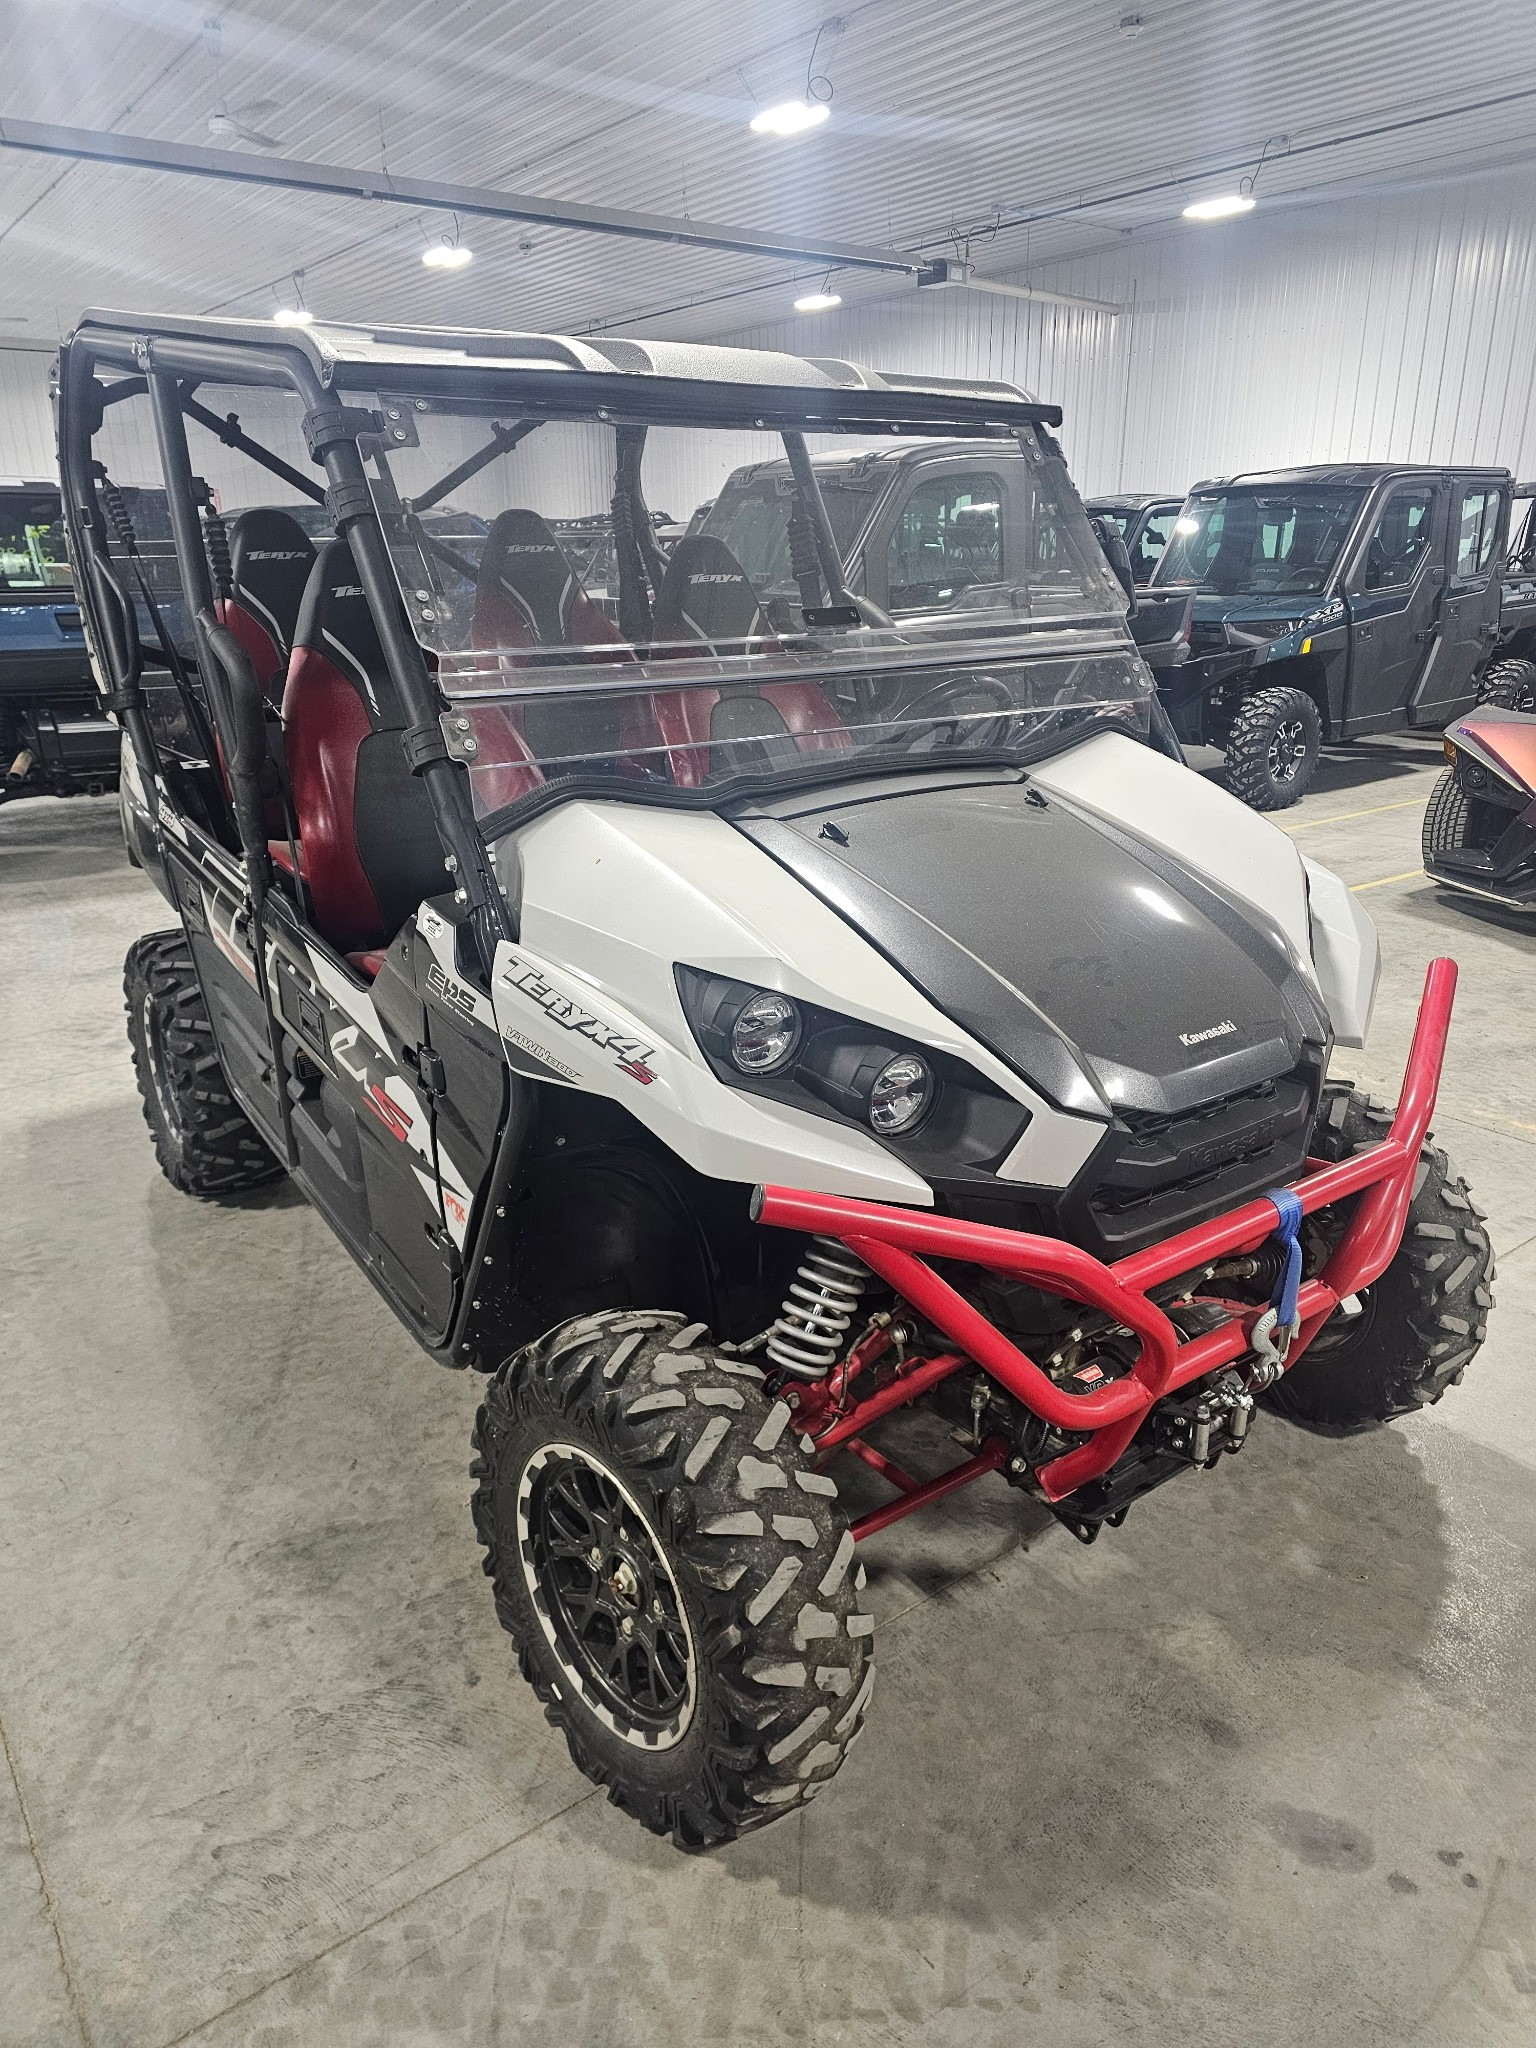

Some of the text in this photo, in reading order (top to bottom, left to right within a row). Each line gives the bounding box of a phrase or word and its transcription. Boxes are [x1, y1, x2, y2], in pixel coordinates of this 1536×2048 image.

[505, 543, 557, 553] TERYX
[246, 550, 310, 561] TERYX
[687, 572, 744, 585] TERYX
[1316, 601, 1343, 618] XP
[1322, 611, 1343, 624] 1000
[427, 963, 477, 1014] EPS
[1178, 1020, 1238, 1047] Kawasaki
